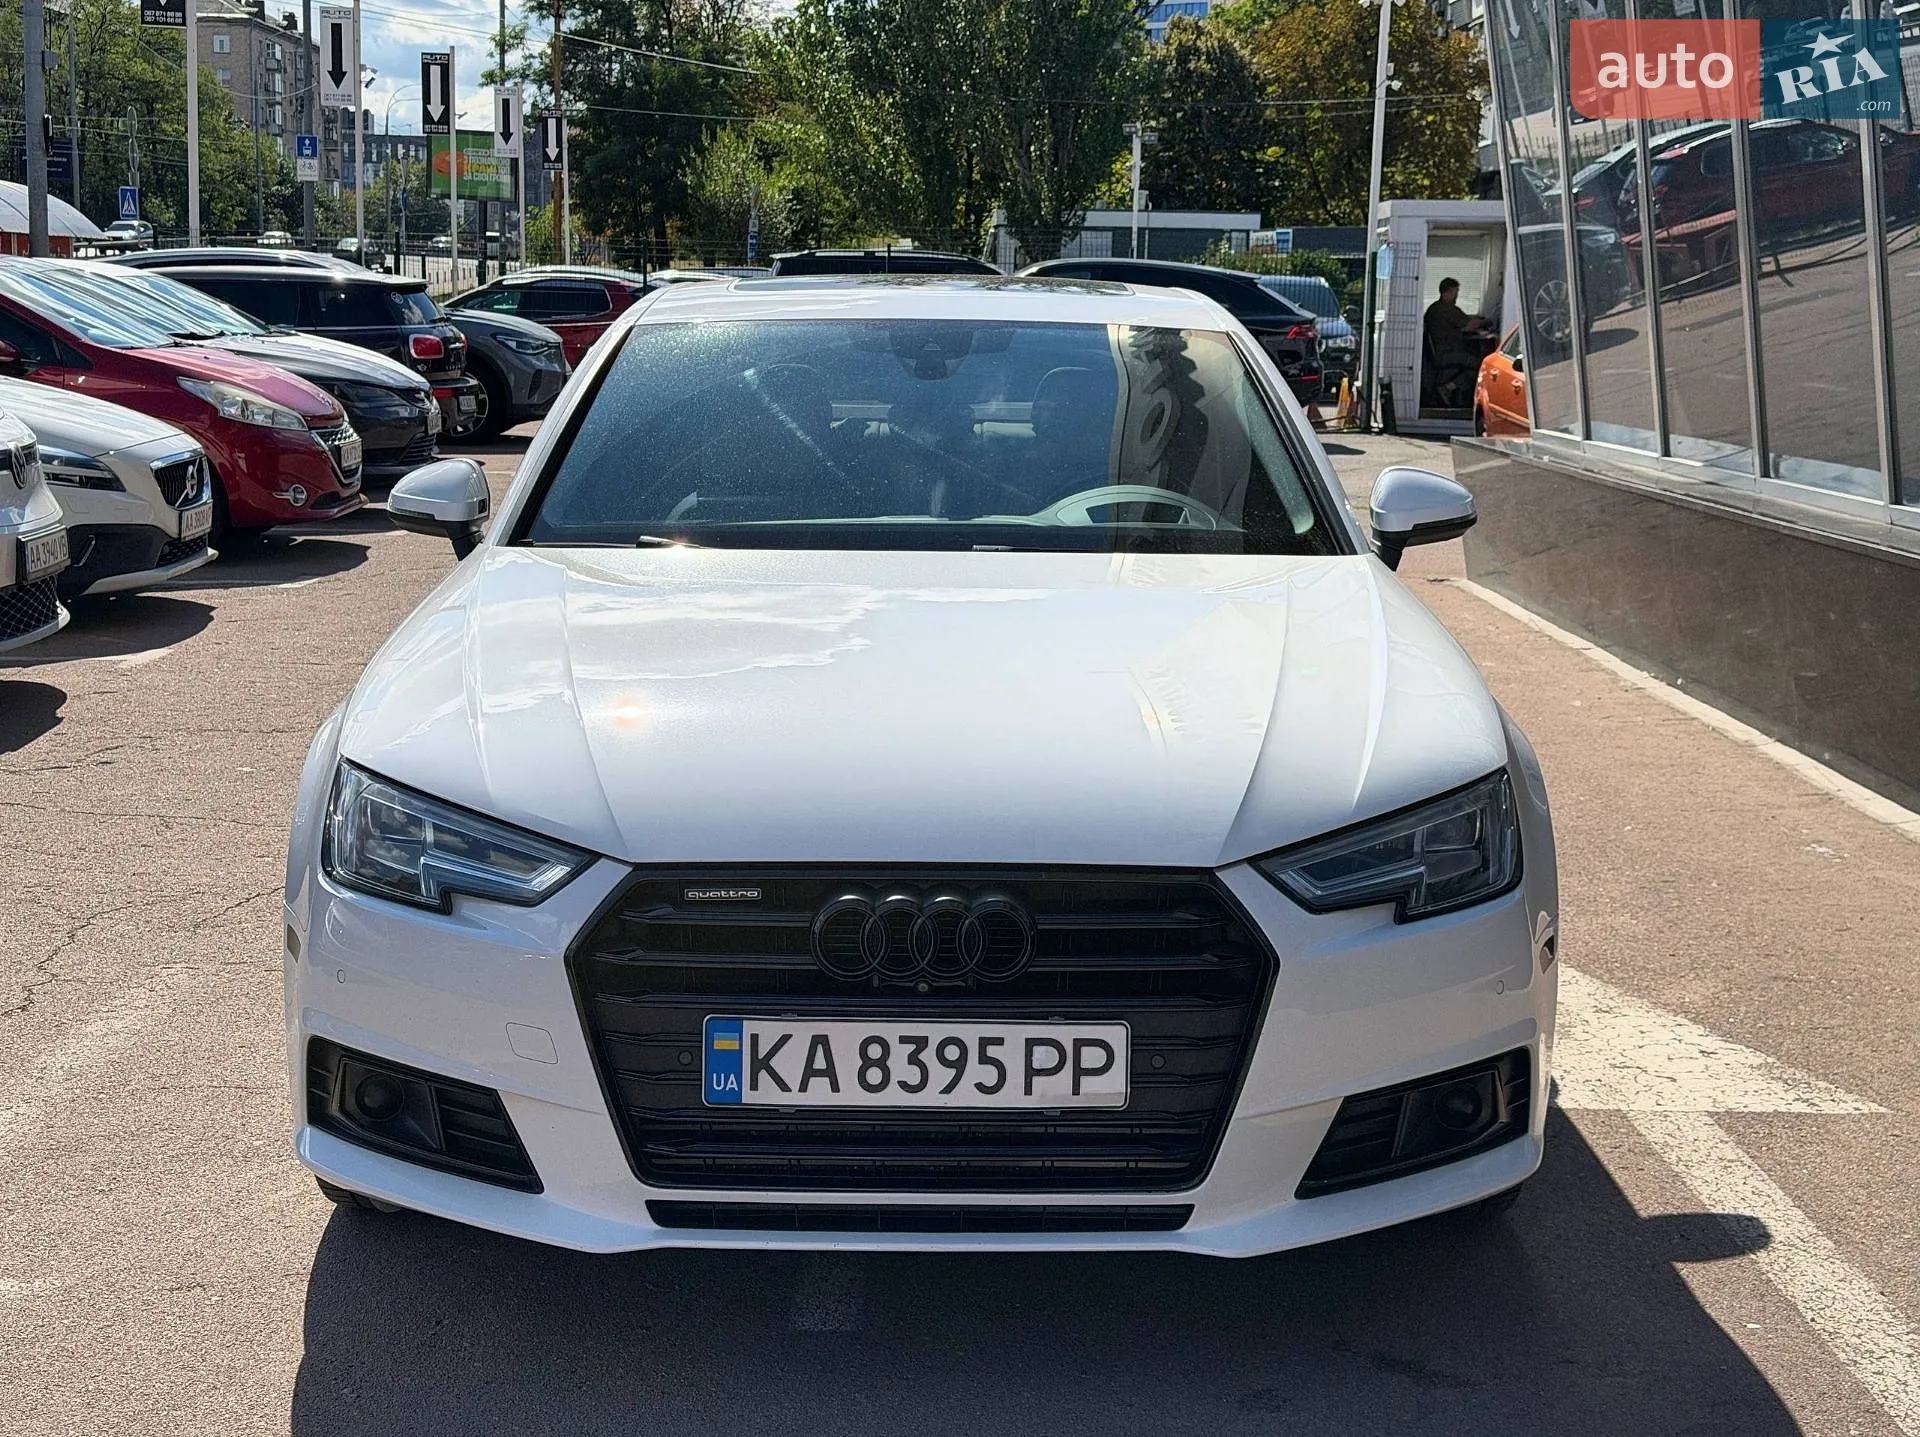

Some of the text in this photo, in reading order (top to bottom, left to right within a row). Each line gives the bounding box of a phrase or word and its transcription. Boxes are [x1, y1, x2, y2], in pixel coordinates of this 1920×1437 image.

[688, 890, 758, 900] quattro
[749, 1033, 1116, 1097] KA 8395 PP
[713, 1073, 738, 1091] UA
